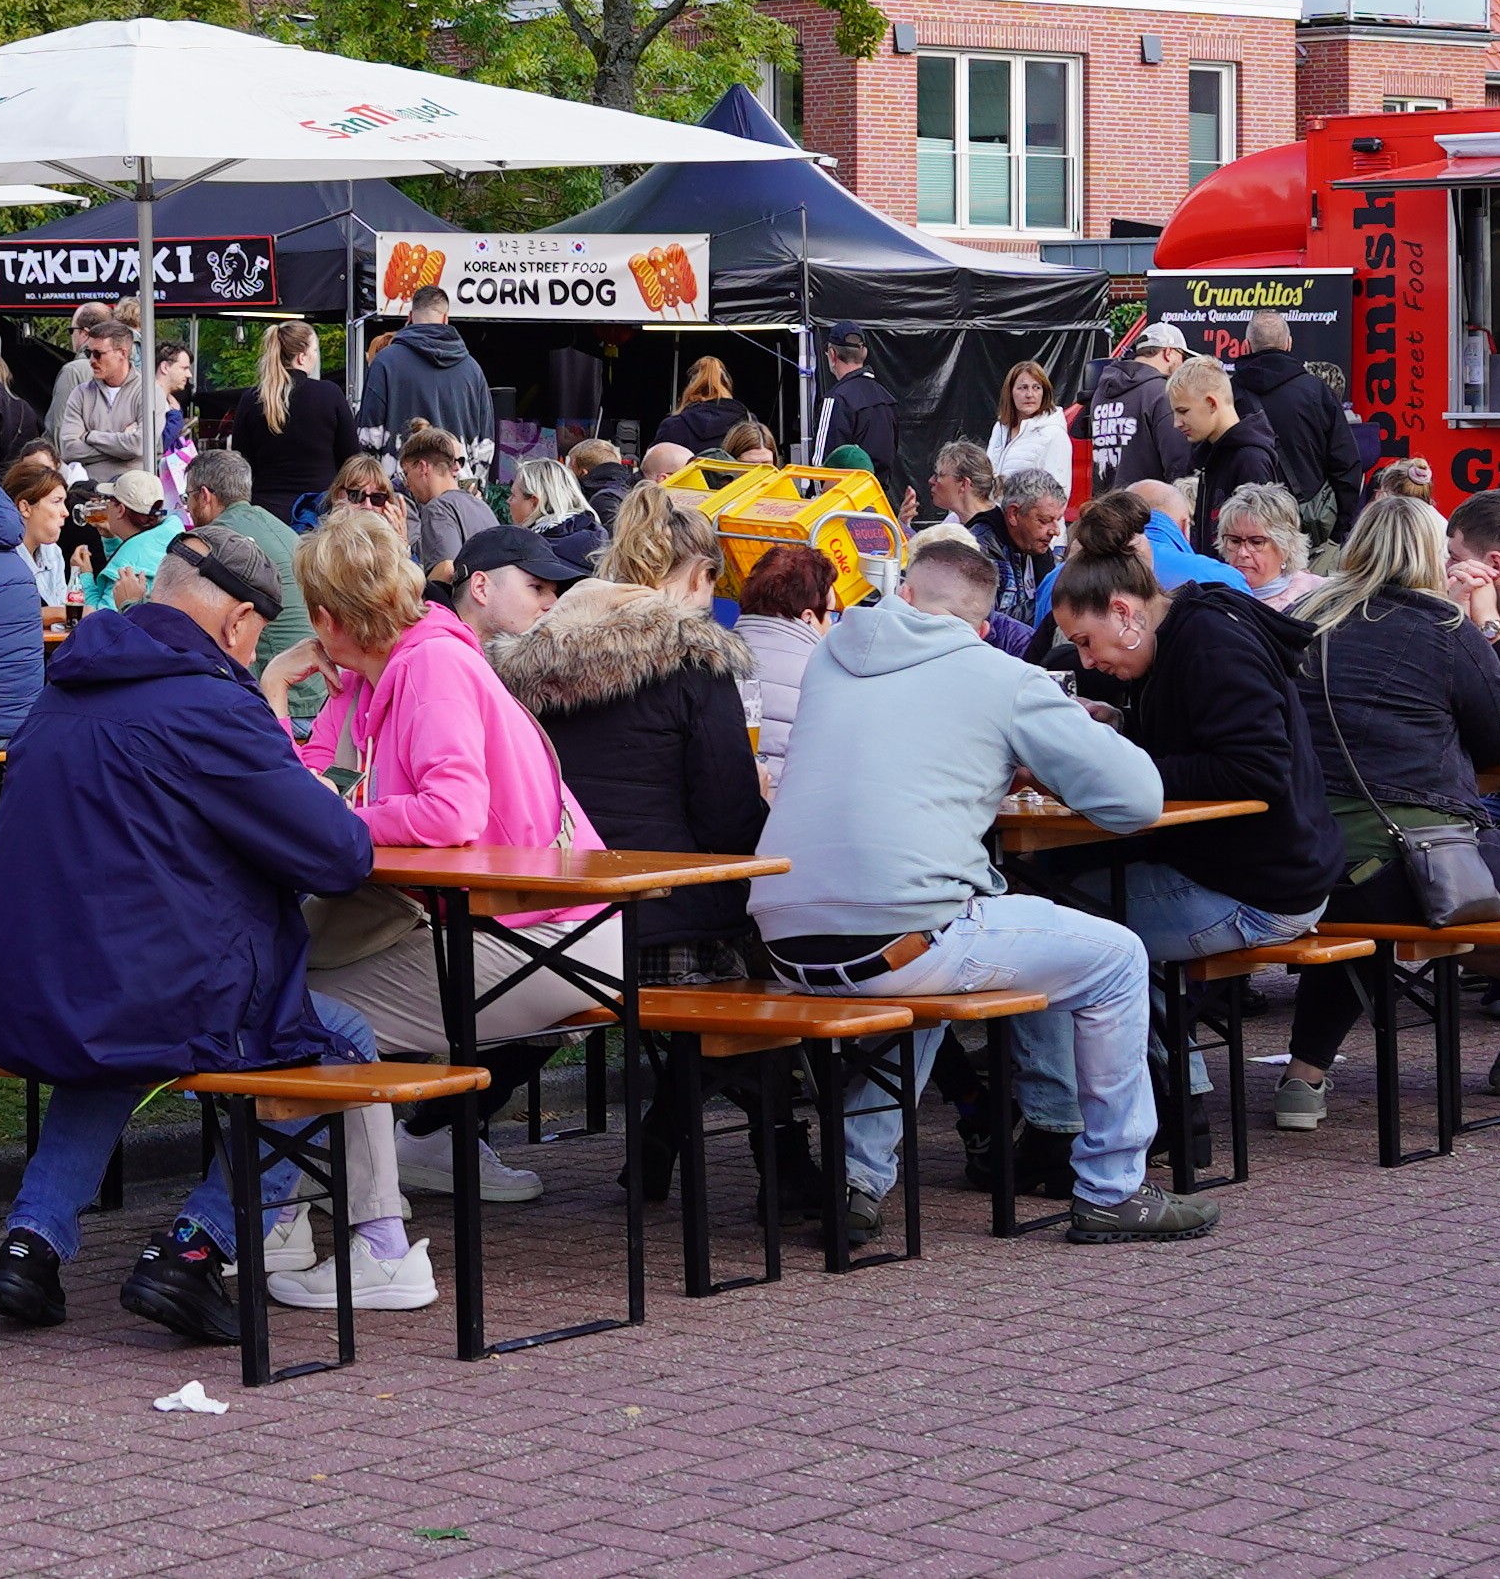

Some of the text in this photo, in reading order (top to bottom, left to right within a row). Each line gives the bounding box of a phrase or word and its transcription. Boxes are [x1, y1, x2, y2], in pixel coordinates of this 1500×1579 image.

[464, 261, 608, 273] KOREAN STREET FOOD
[41, 292, 75, 300] JAPANESE
[456, 277, 617, 307] CORN DOG
[1186, 278, 1315, 308] "Crunchitos"
[1161, 309, 1207, 324] spanische
[1353, 190, 1410, 459] panish
[1402, 240, 1425, 433] Street Food
[1093, 402, 1125, 420] COLD
[1092, 416, 1138, 437] EARTS
[829, 537, 852, 576] Coke
